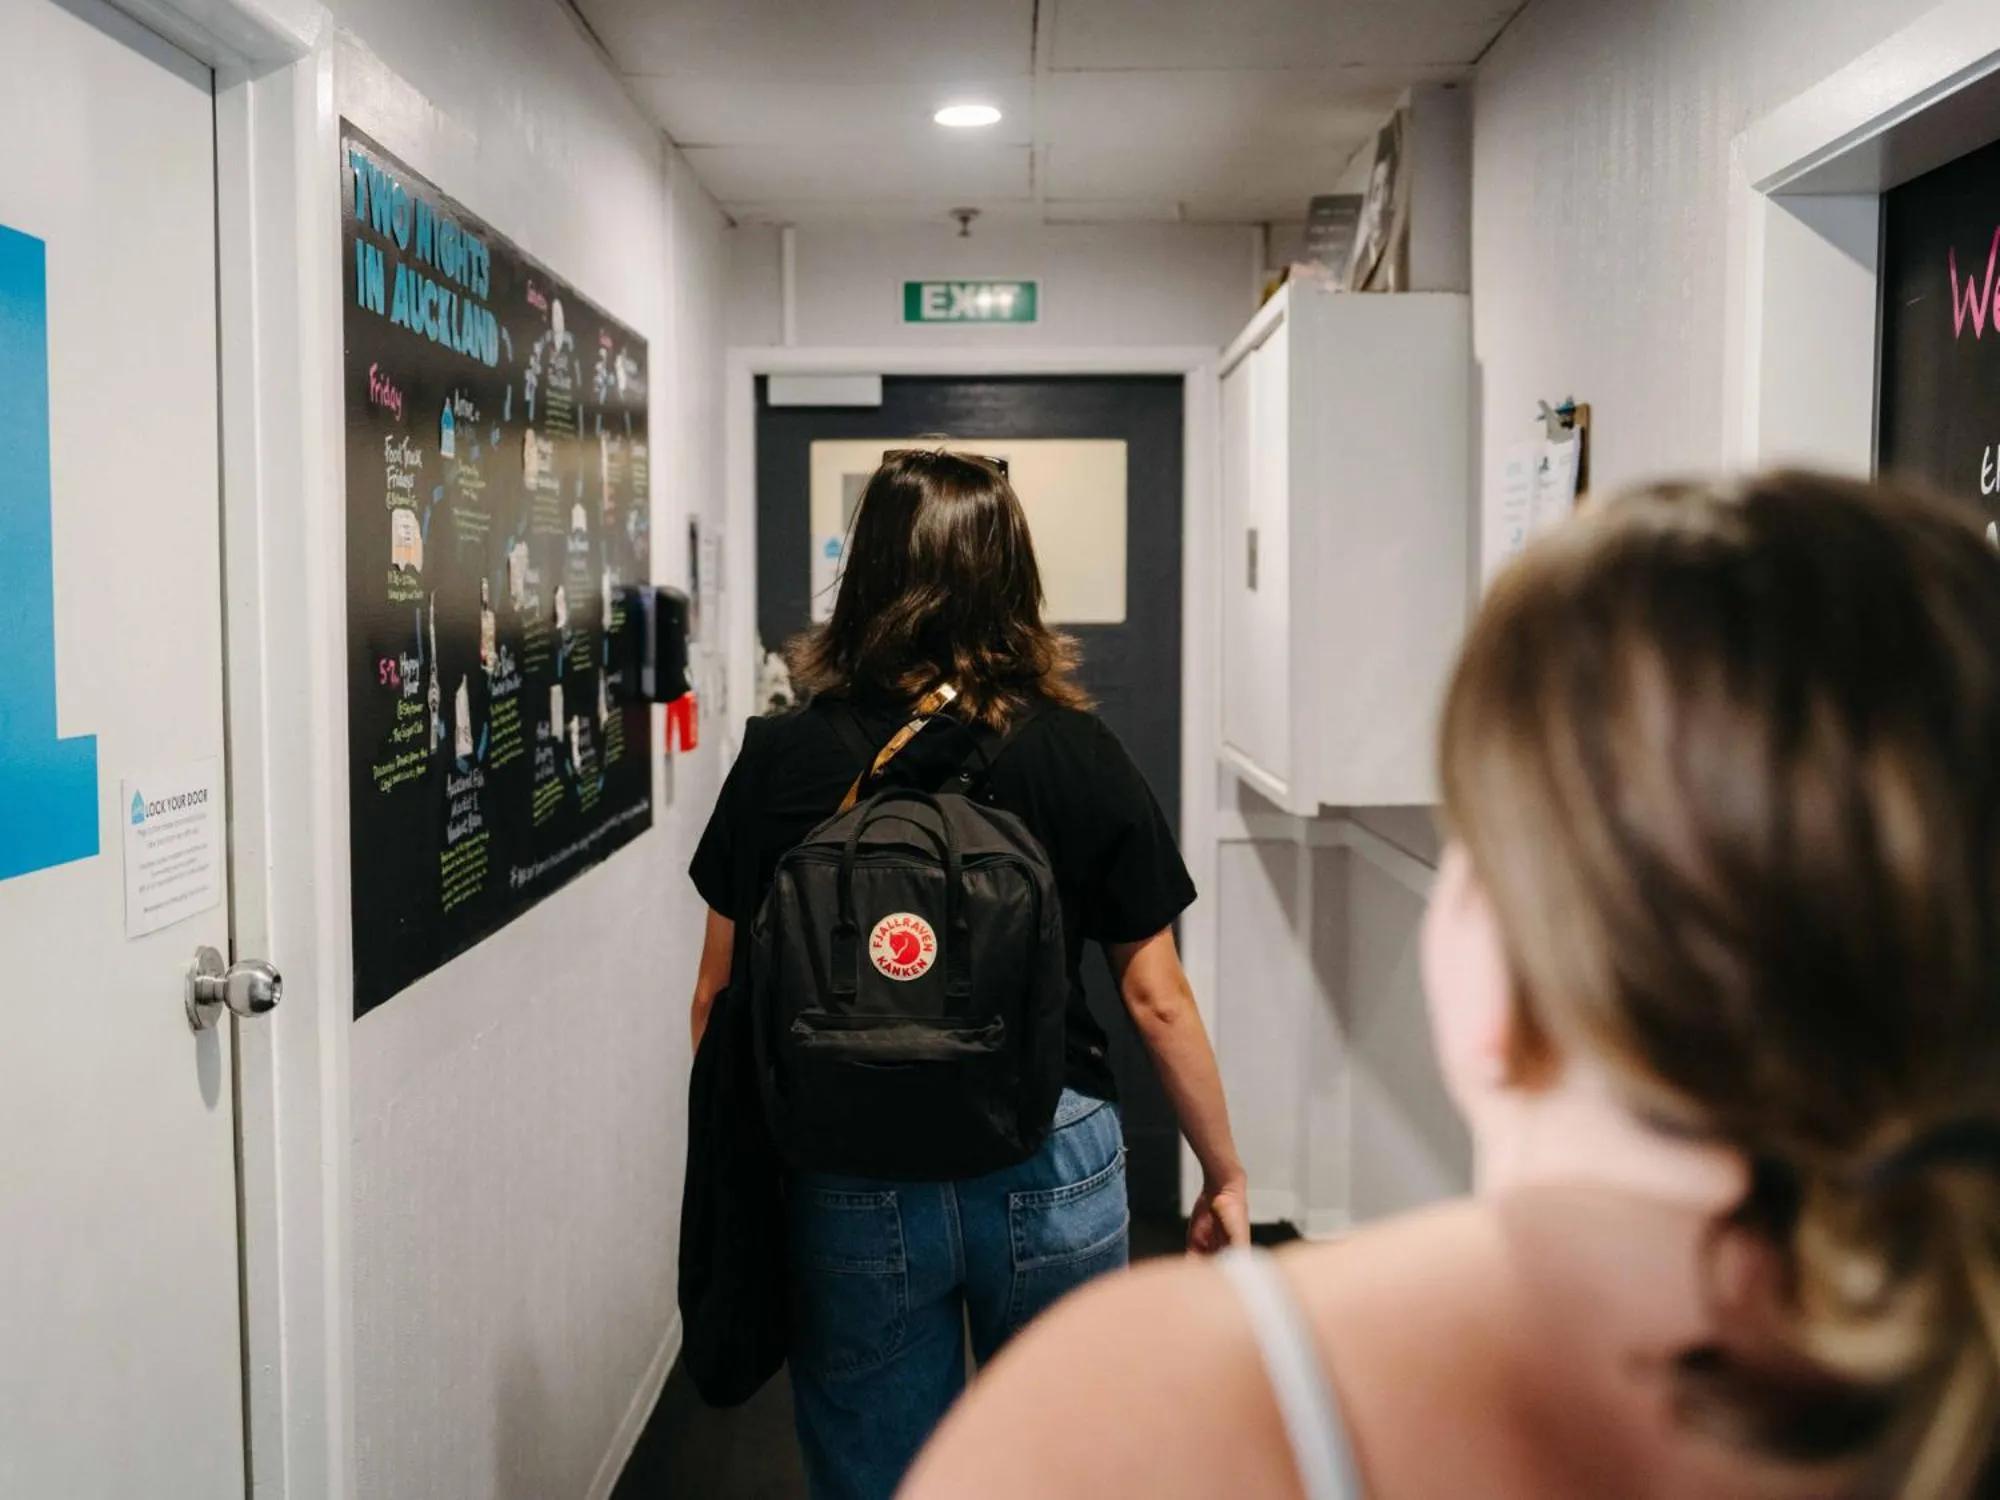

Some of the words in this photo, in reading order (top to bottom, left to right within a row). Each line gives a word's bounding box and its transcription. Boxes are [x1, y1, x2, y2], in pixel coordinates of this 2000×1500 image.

[350, 148, 411, 250] TWO
[415, 197, 489, 301] NIGHTS
[355, 238, 385, 316] IN
[390, 261, 498, 367] AUCKLAND
[922, 284, 1020, 320] EXIT
[369, 362, 402, 421] Friday
[146, 800, 166, 818] LOCK
[166, 793, 186, 813] YOUR
[187, 789, 208, 807] DOOR
